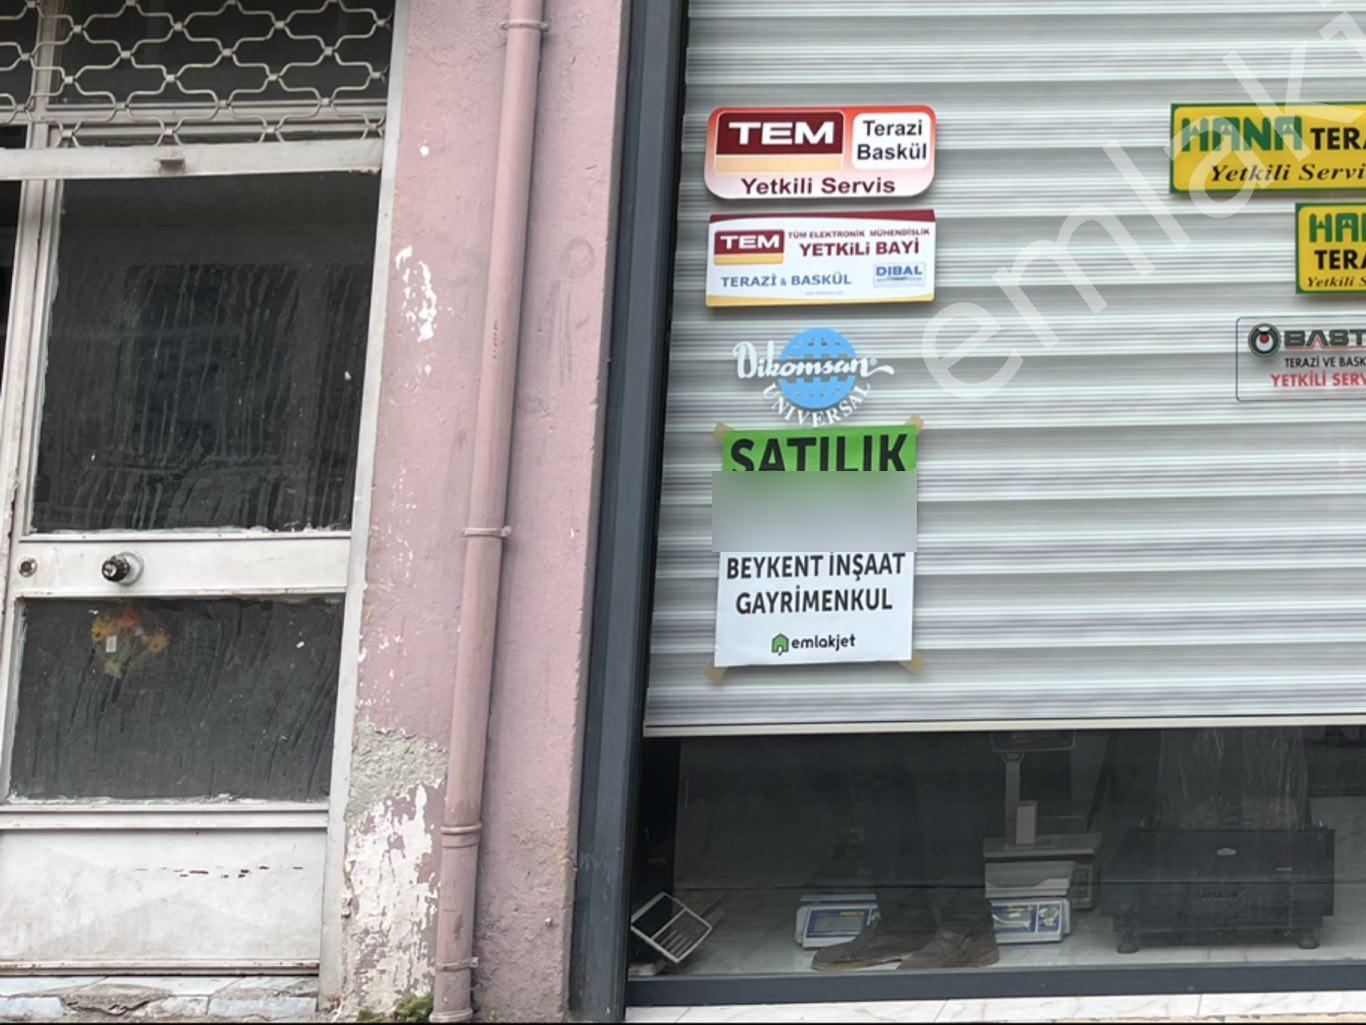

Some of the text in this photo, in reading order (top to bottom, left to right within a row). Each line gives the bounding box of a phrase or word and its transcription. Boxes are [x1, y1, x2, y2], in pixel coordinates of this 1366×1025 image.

[728, 121, 834, 145] TEM
[863, 120, 922, 136] Terazi
[1181, 115, 1302, 152] HANA
[857, 144, 927, 160] Baskül
[1210, 164, 1291, 181] Yetkili
[741, 177, 895, 194] Yetkili Servis
[720, 235, 780, 249] TEM
[876, 237, 919, 255] BAYİ
[720, 273, 777, 287] TERAZİ
[791, 272, 852, 286] BASKÜL
[876, 266, 922, 276] DIBAL
[1307, 276, 1354, 288] Yetkili
[732, 340, 895, 379] Dikomsan
[1285, 356, 1319, 368] TERAZİ
[1322, 357, 1336, 368] VE
[1271, 370, 1326, 387] YETKİLİ
[762, 382, 871, 427] UNIVERSAL
[730, 434, 908, 471] SATILIK
[727, 555, 823, 579] BEYKENT
[736, 585, 892, 614] GAYRİMENKUL
[791, 633, 856, 651] emlakjet
